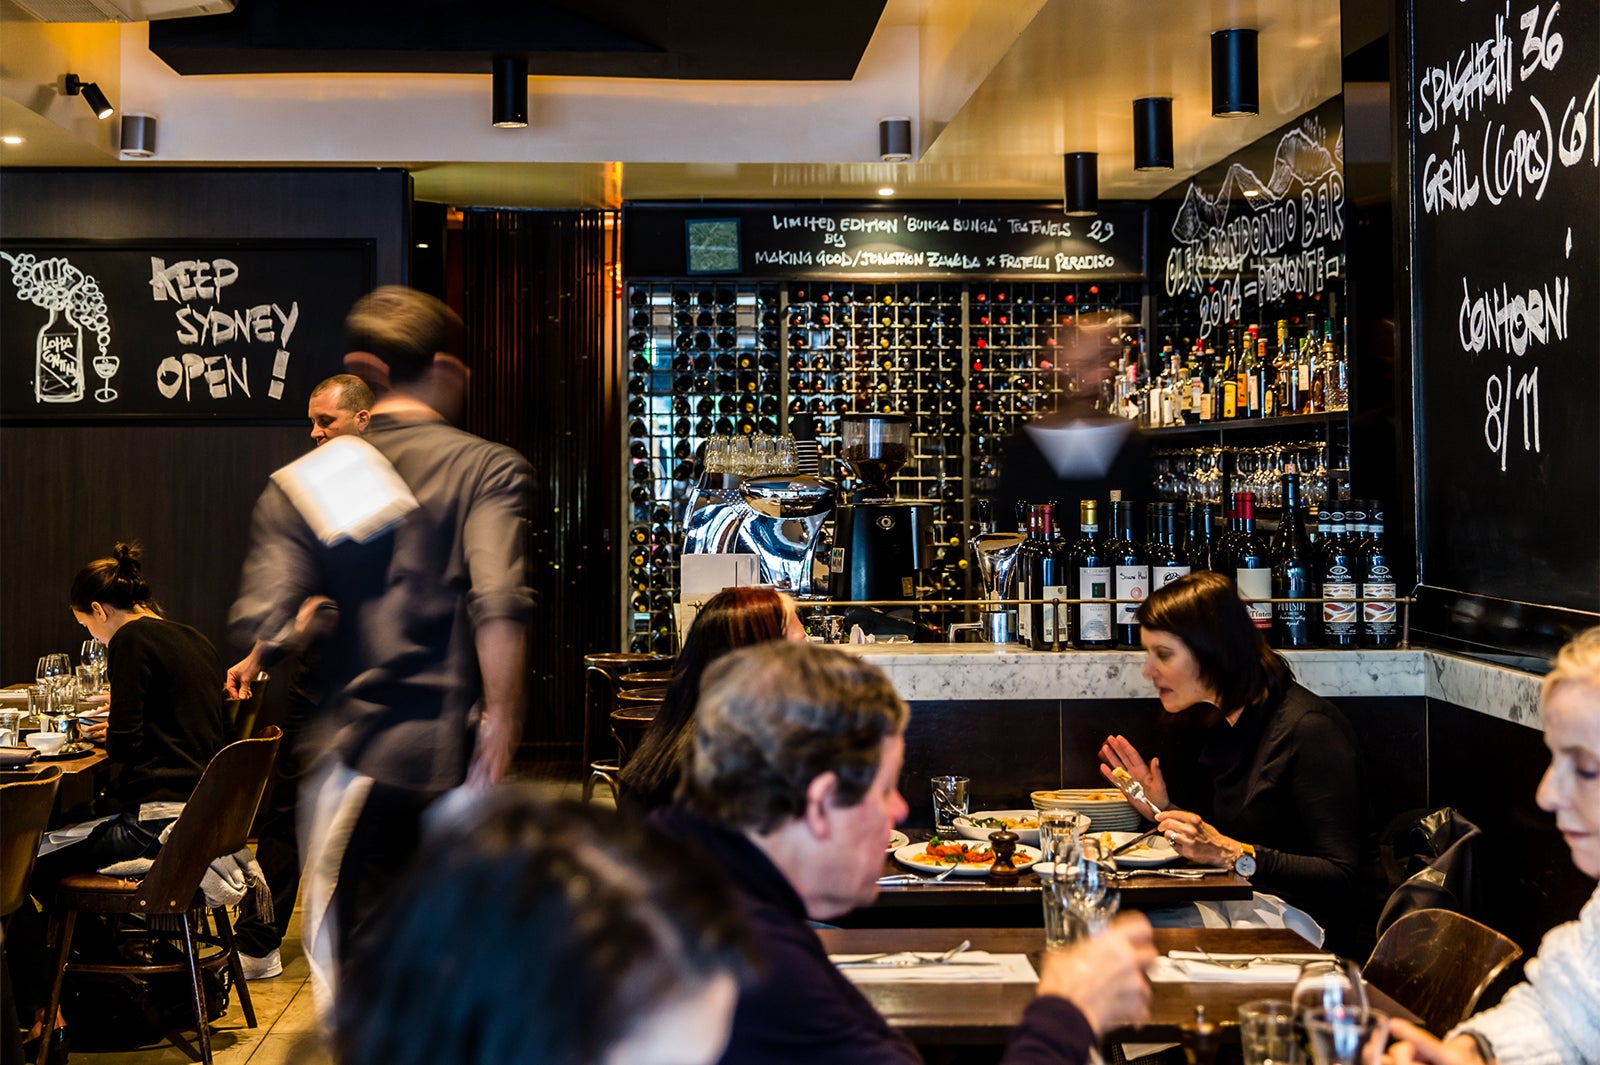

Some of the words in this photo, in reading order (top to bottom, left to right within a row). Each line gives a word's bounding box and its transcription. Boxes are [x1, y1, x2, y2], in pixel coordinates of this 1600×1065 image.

[1520, 1, 1564, 82] 36
[840, 217, 898, 233] EDITION
[1086, 220, 1115, 243] 29
[1301, 171, 1345, 248] BAR
[755, 250, 812, 266] MAKING
[999, 253, 1050, 270] FRATELLI
[1055, 252, 1115, 272] PARADISO
[824, 233, 846, 248] BY
[149, 256, 239, 303] KEEP
[1200, 273, 1243, 339] 2014
[1459, 227, 1573, 356] CONTORNI
[176, 301, 299, 348] SYDNEY
[1485, 365, 1540, 471] 8/11
